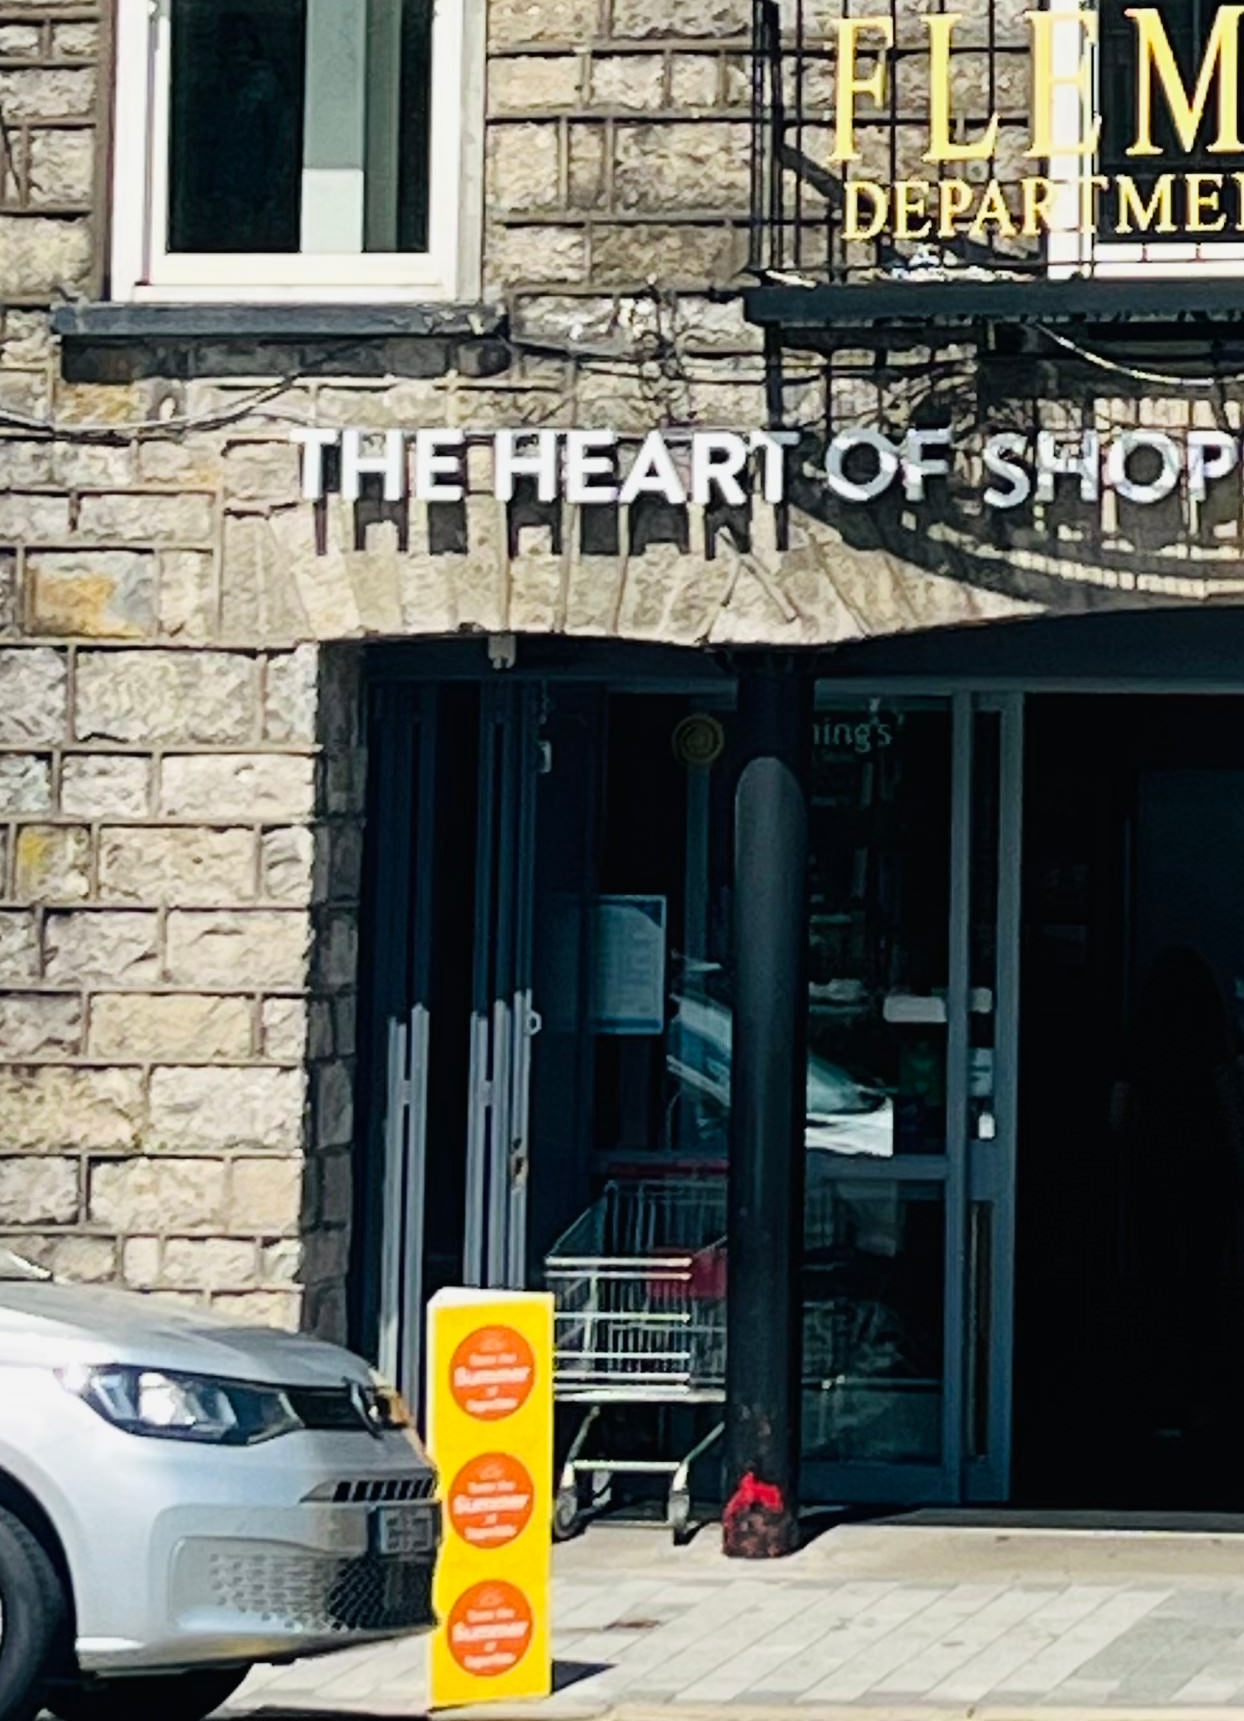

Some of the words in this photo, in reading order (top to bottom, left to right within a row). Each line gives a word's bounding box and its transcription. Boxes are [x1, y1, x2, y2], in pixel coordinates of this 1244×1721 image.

[289, 427, 467, 502] THE
[493, 428, 801, 504] HEART
[823, 426, 956, 503] OF
